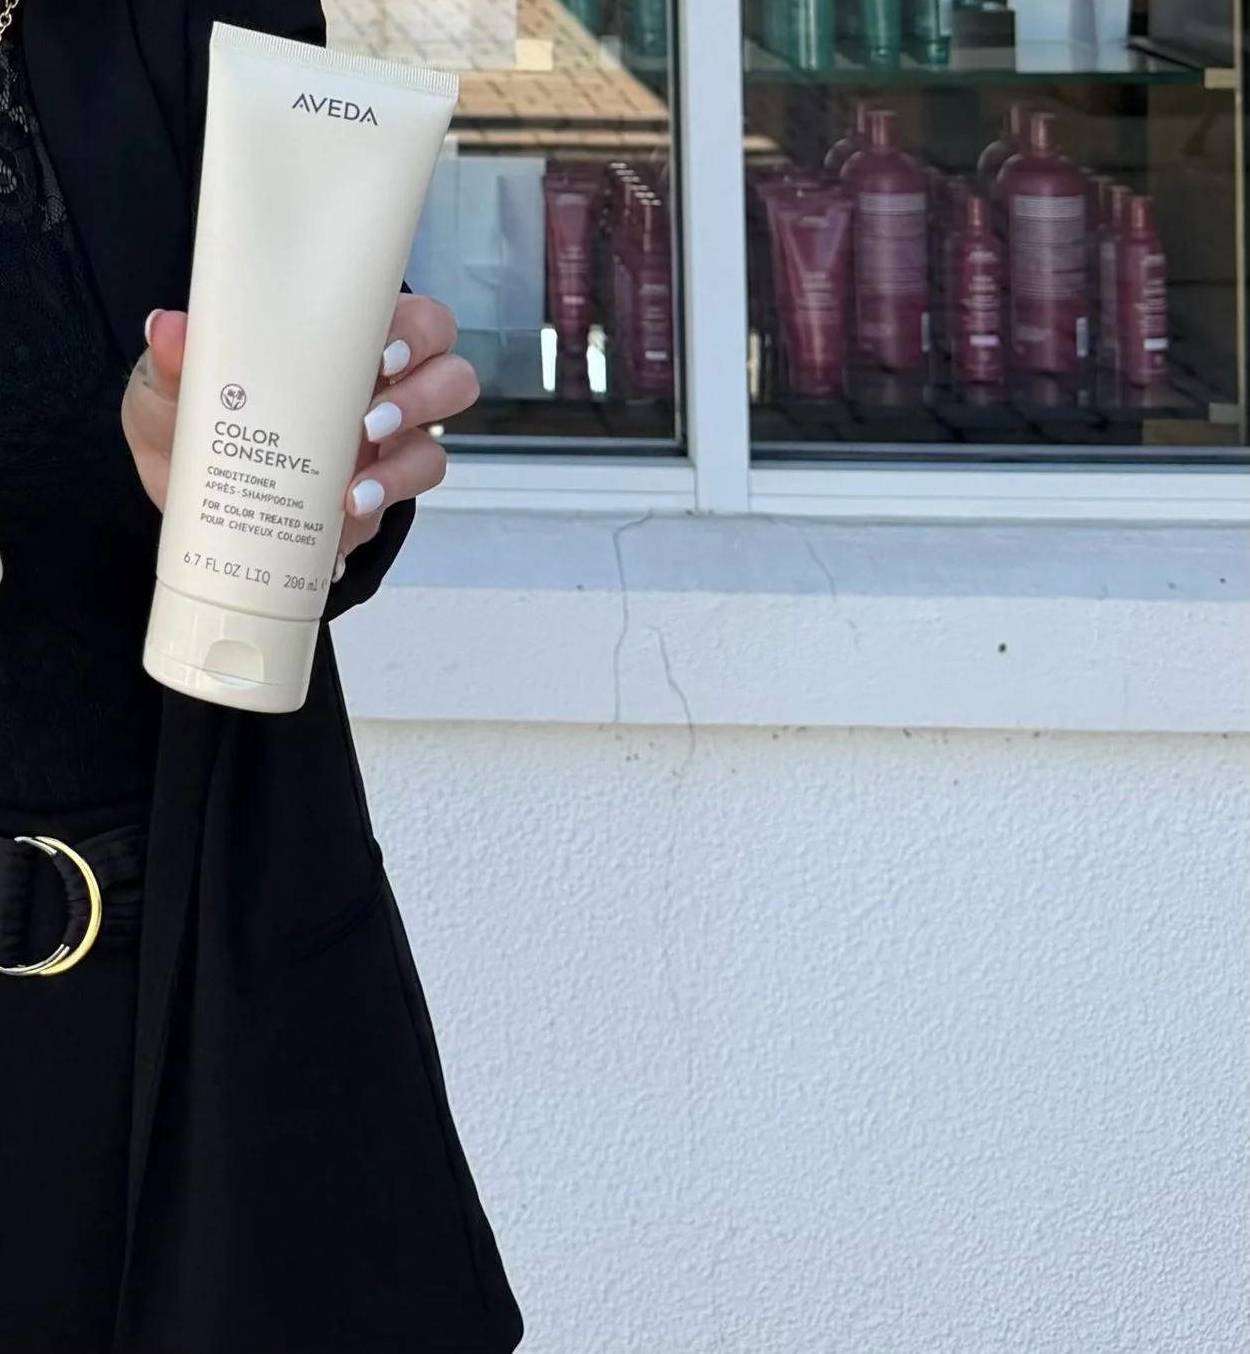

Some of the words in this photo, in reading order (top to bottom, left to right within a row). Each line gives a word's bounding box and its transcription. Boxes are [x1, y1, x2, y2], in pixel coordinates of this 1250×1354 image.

[291, 92, 378, 126] AVEDA
[214, 420, 280, 448] COLOR
[207, 465, 277, 489] CONDITIONER
[200, 512, 225, 527] POUR
[228, 520, 274, 538] CHEVEUX
[277, 529, 317, 546] COLORÉS
[202, 498, 221, 511] FOR
[224, 504, 255, 519] COLOR
[259, 512, 301, 529] TREATED
[303, 521, 324, 532] HAIR
[183, 551, 202, 567] 6.7
[205, 557, 220, 573] FL
[223, 562, 241, 578] OZ
[245, 567, 271, 586] LIQ
[283, 574, 305, 590] 200
